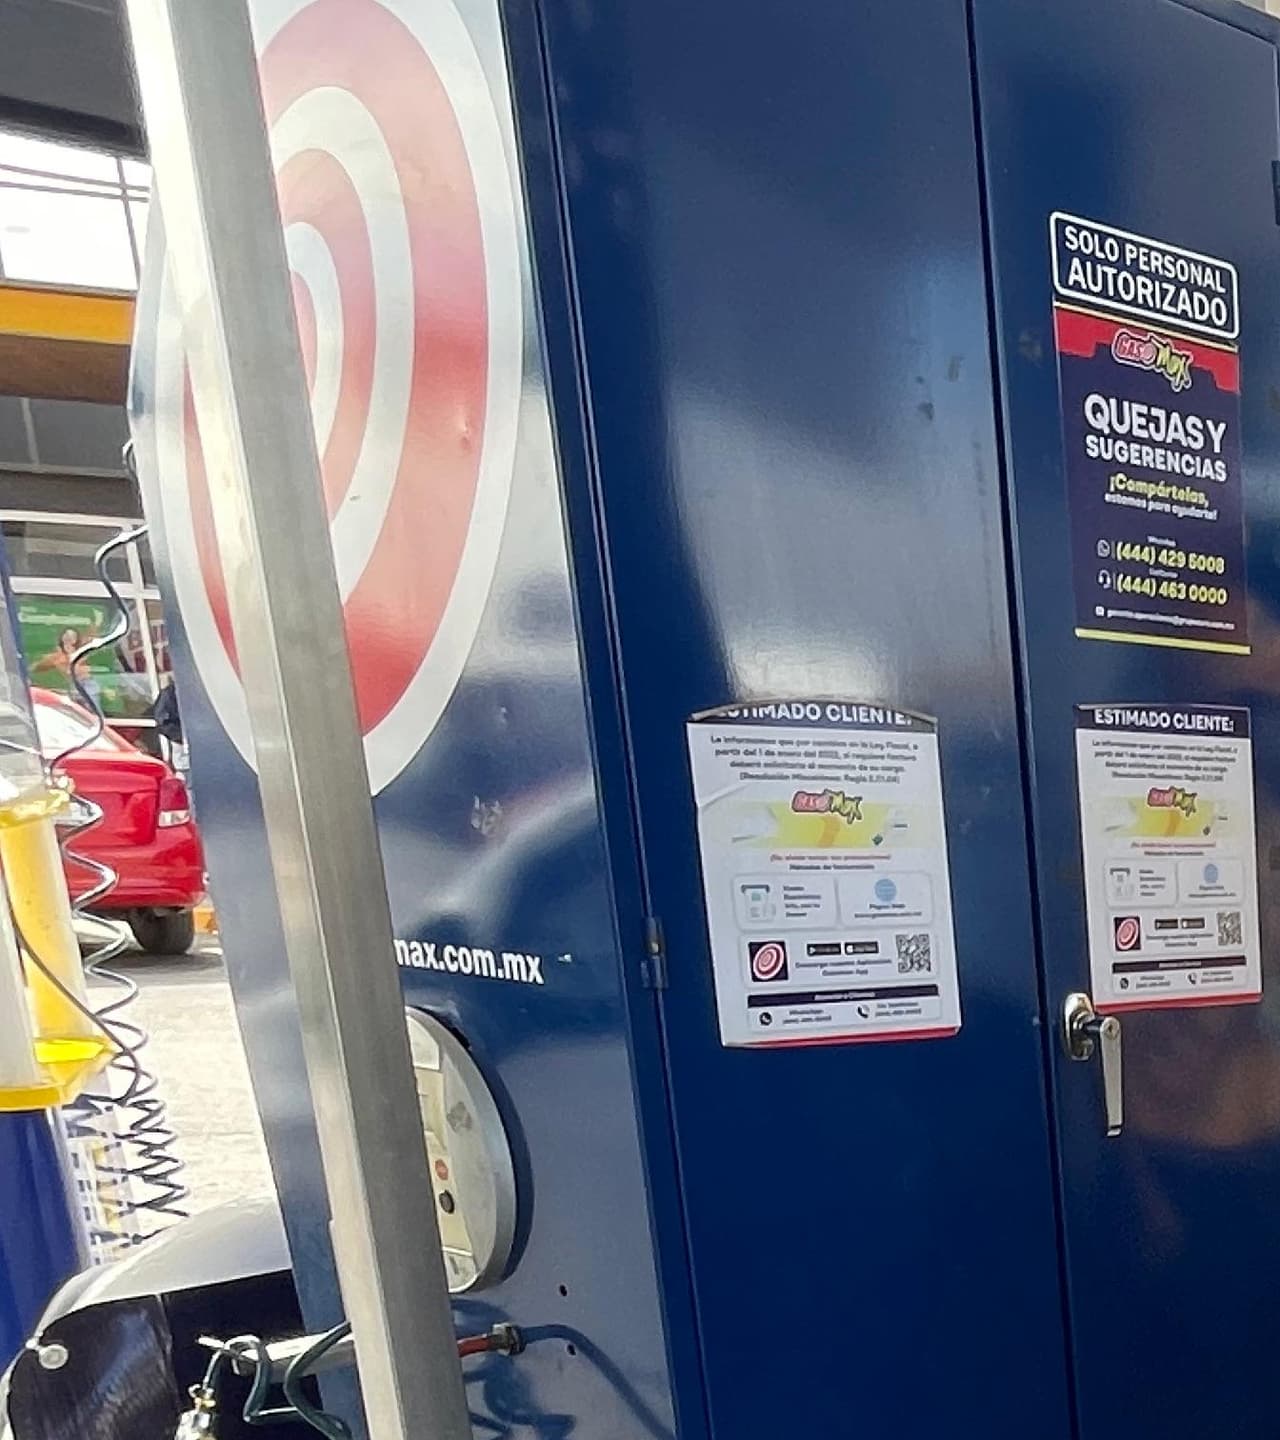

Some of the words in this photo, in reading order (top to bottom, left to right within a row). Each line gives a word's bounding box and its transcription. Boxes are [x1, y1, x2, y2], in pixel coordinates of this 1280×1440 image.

[1065, 225, 1119, 262] SOLO
[1125, 242, 1226, 293] PERSONAL
[1068, 257, 1227, 326] AUTORIZADO
[1084, 393, 1204, 450] QUEJAS
[1206, 420, 1226, 453] Y
[1086, 435, 1227, 482] SUGERENCIAS
[1117, 541, 1156, 565] (444)
[1158, 548, 1186, 568] 429
[1117, 573, 1156, 598] (444)
[1189, 584, 1227, 605] 0000
[1094, 708, 1170, 729] ESTIMADO
[1173, 712, 1235, 733] CLIENTE:
[393, 938, 545, 985] max.com.mx
